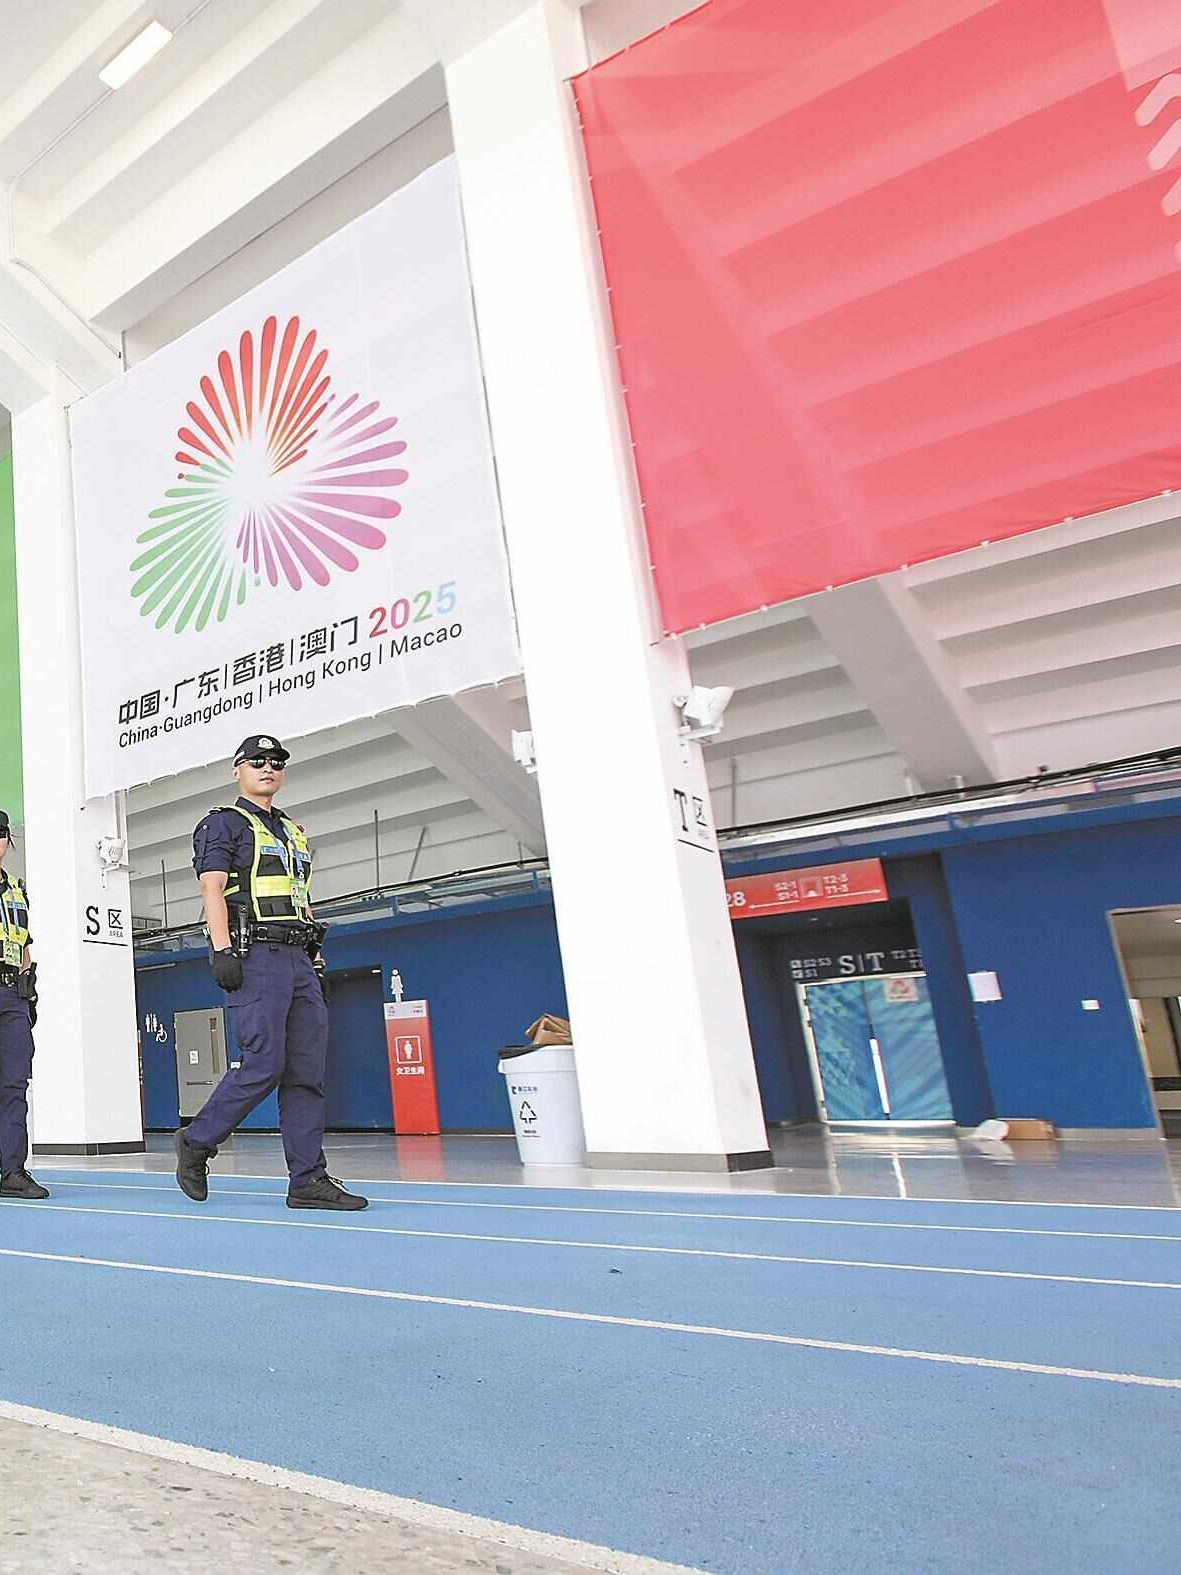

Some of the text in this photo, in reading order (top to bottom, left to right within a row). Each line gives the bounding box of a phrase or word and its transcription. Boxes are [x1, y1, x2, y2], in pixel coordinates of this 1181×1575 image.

[368, 580, 457, 639] 2025
[268, 670, 316, 698] Hong
[322, 651, 372, 680] Kong
[390, 622, 463, 658] Macao
